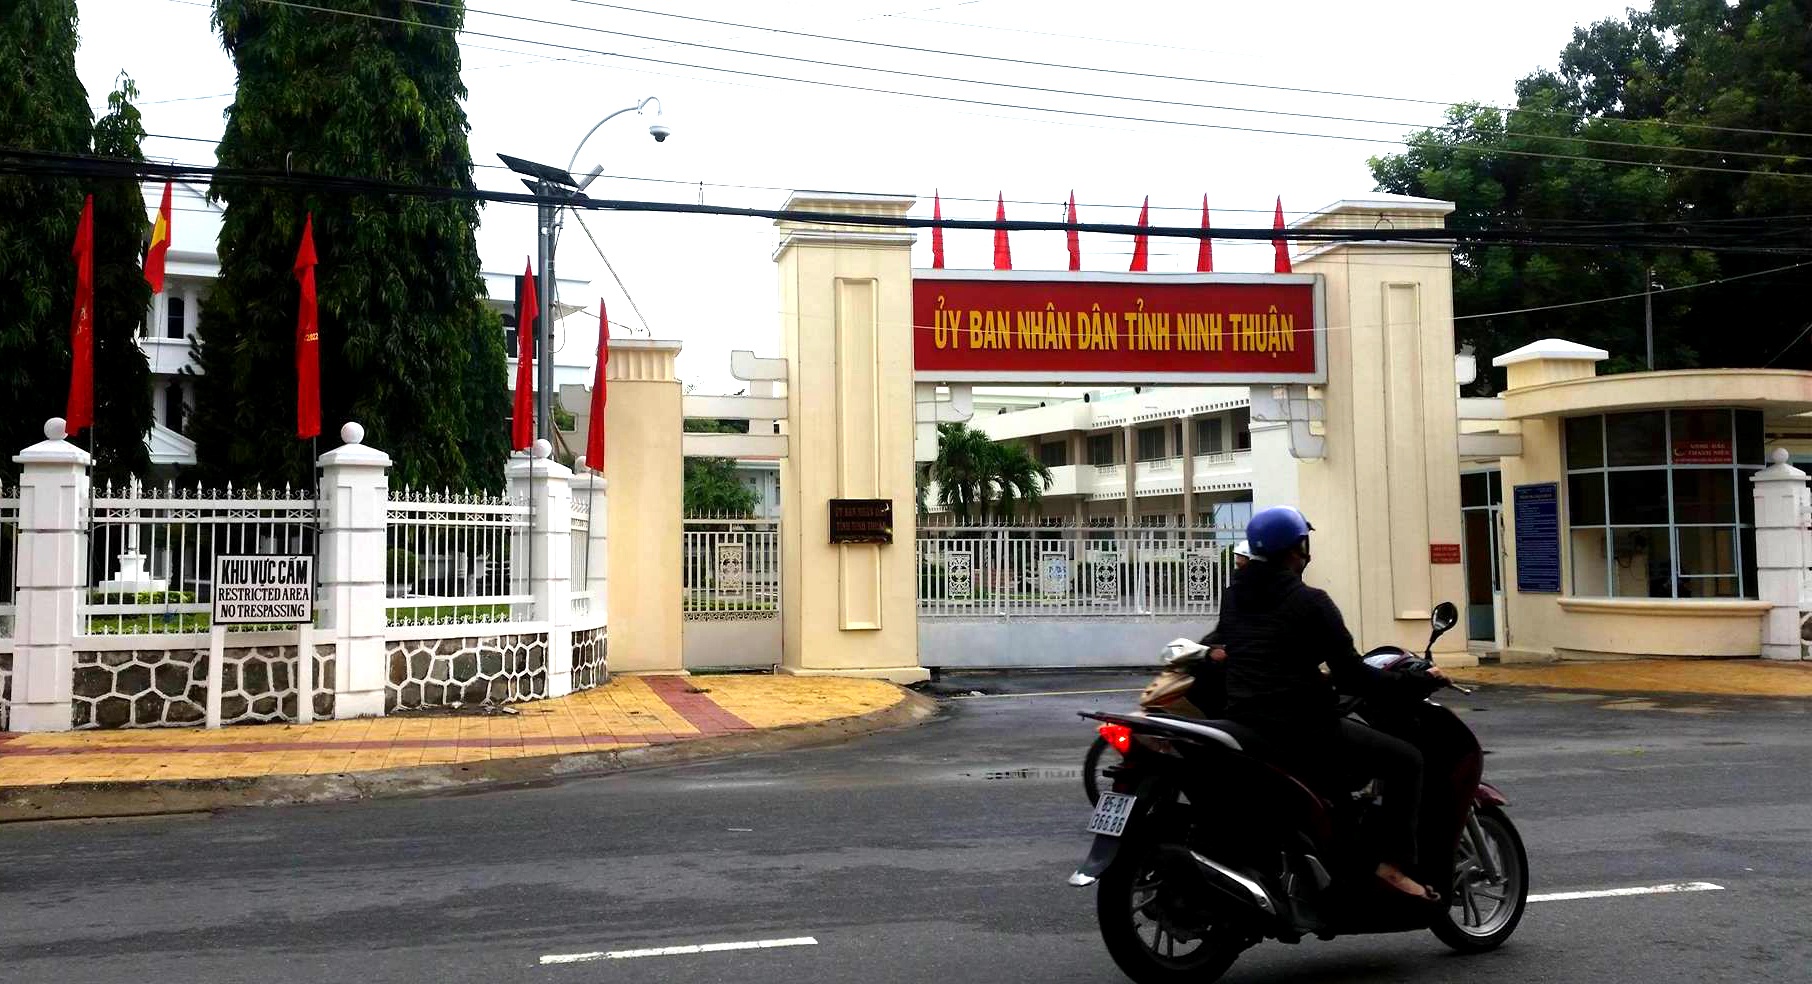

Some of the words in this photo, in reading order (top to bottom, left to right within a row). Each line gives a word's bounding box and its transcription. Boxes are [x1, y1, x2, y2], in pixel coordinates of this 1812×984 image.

[934, 295, 962, 349] ỦY
[969, 310, 1011, 349] BAN
[1017, 302, 1071, 350] NHÂN
[1077, 303, 1118, 350] DÂN
[1124, 298, 1171, 351] TỈNH
[1177, 312, 1223, 351] NINH
[1229, 304, 1295, 358] THUẬN
[221, 560, 249, 585] KHU
[250, 558, 276, 587] VỰC
[277, 556, 307, 585] CẤM
[218, 588, 281, 601] RESTRICTED
[282, 588, 309, 601] AREA
[220, 604, 236, 618] NO
[237, 604, 305, 618] TRESPASSING
